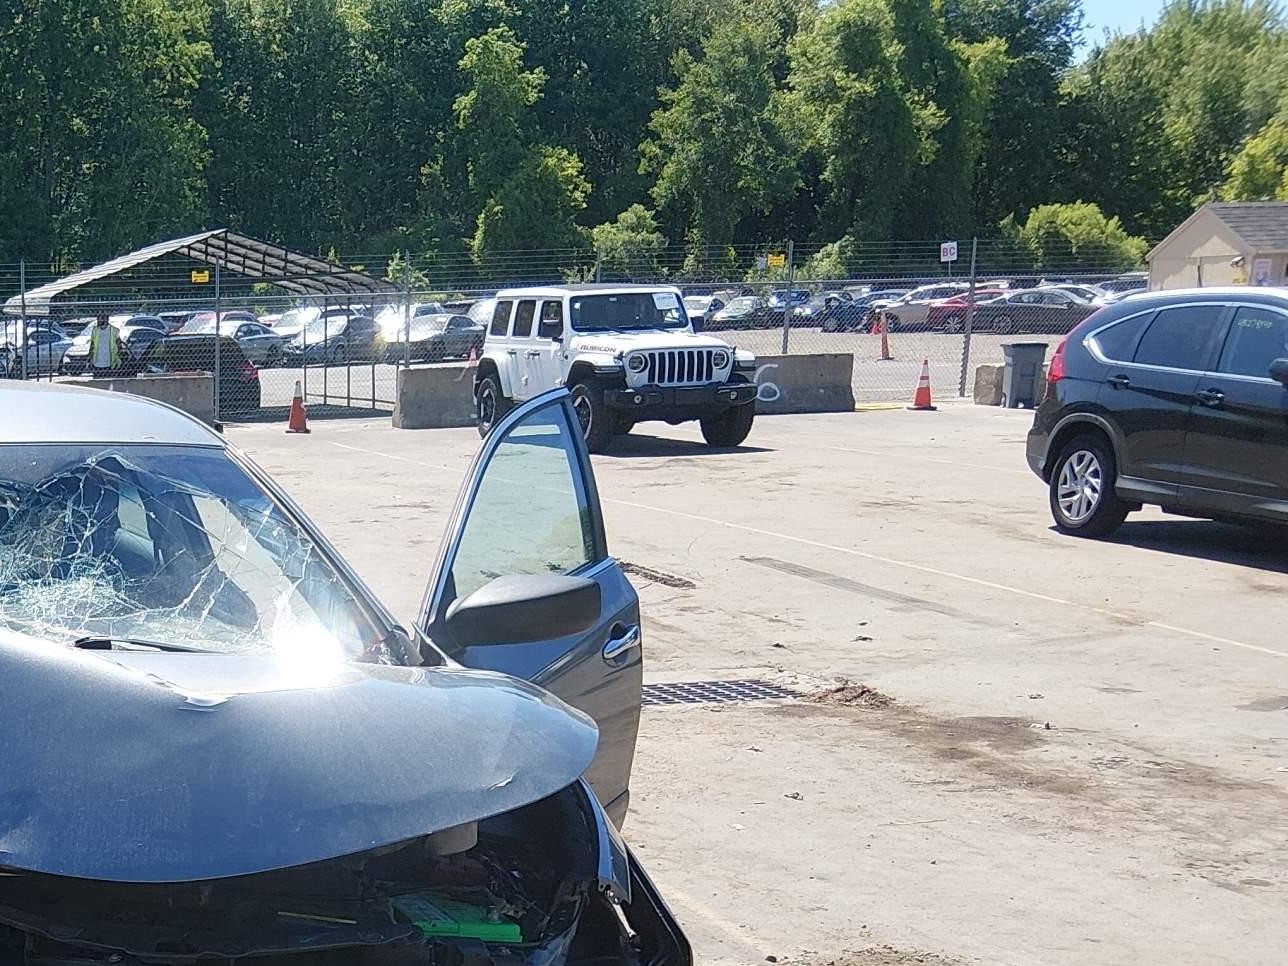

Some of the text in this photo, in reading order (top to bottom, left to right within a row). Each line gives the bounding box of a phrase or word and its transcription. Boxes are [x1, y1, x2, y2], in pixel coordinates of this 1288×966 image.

[943, 246, 956, 257] BC
[580, 344, 617, 353] RUBICON
[753, 363, 780, 401] 6
